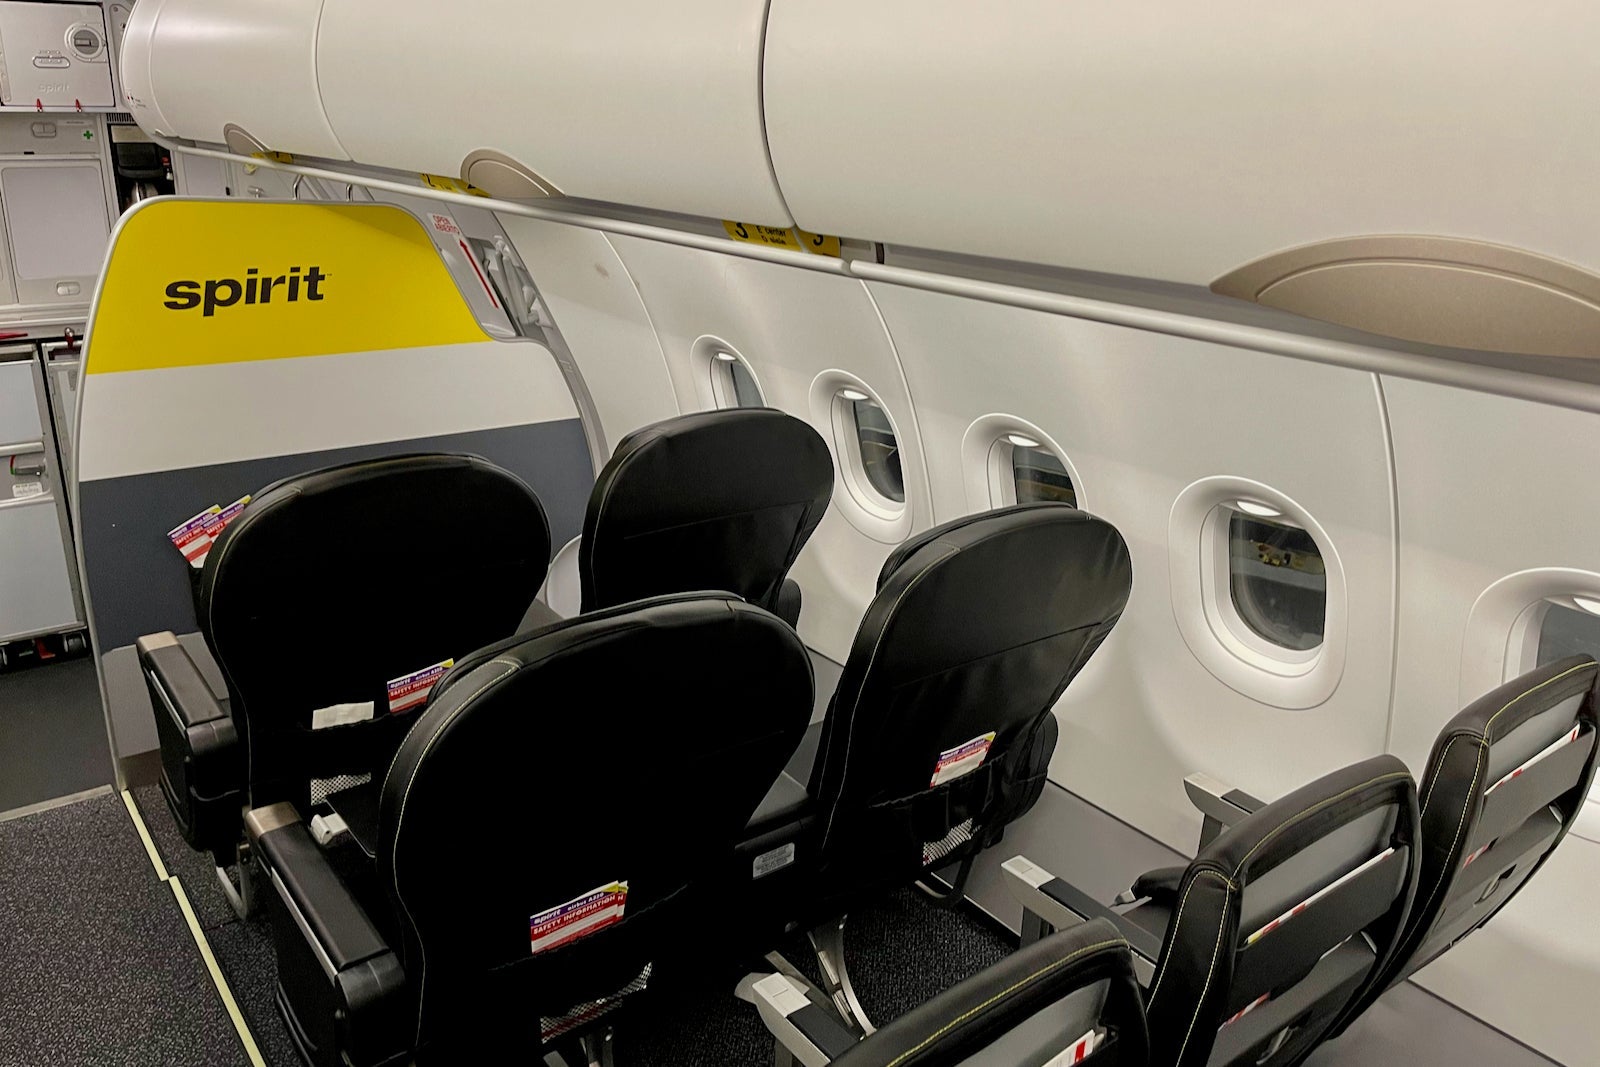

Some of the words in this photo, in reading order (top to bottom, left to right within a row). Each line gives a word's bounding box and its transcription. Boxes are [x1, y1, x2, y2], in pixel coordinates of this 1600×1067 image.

[163, 266, 326, 317] spirit
[533, 918, 562, 935] SAFETY
[563, 894, 616, 922] INFORMATION
[534, 908, 562, 925] spirit
[567, 900, 587, 912] airbus
